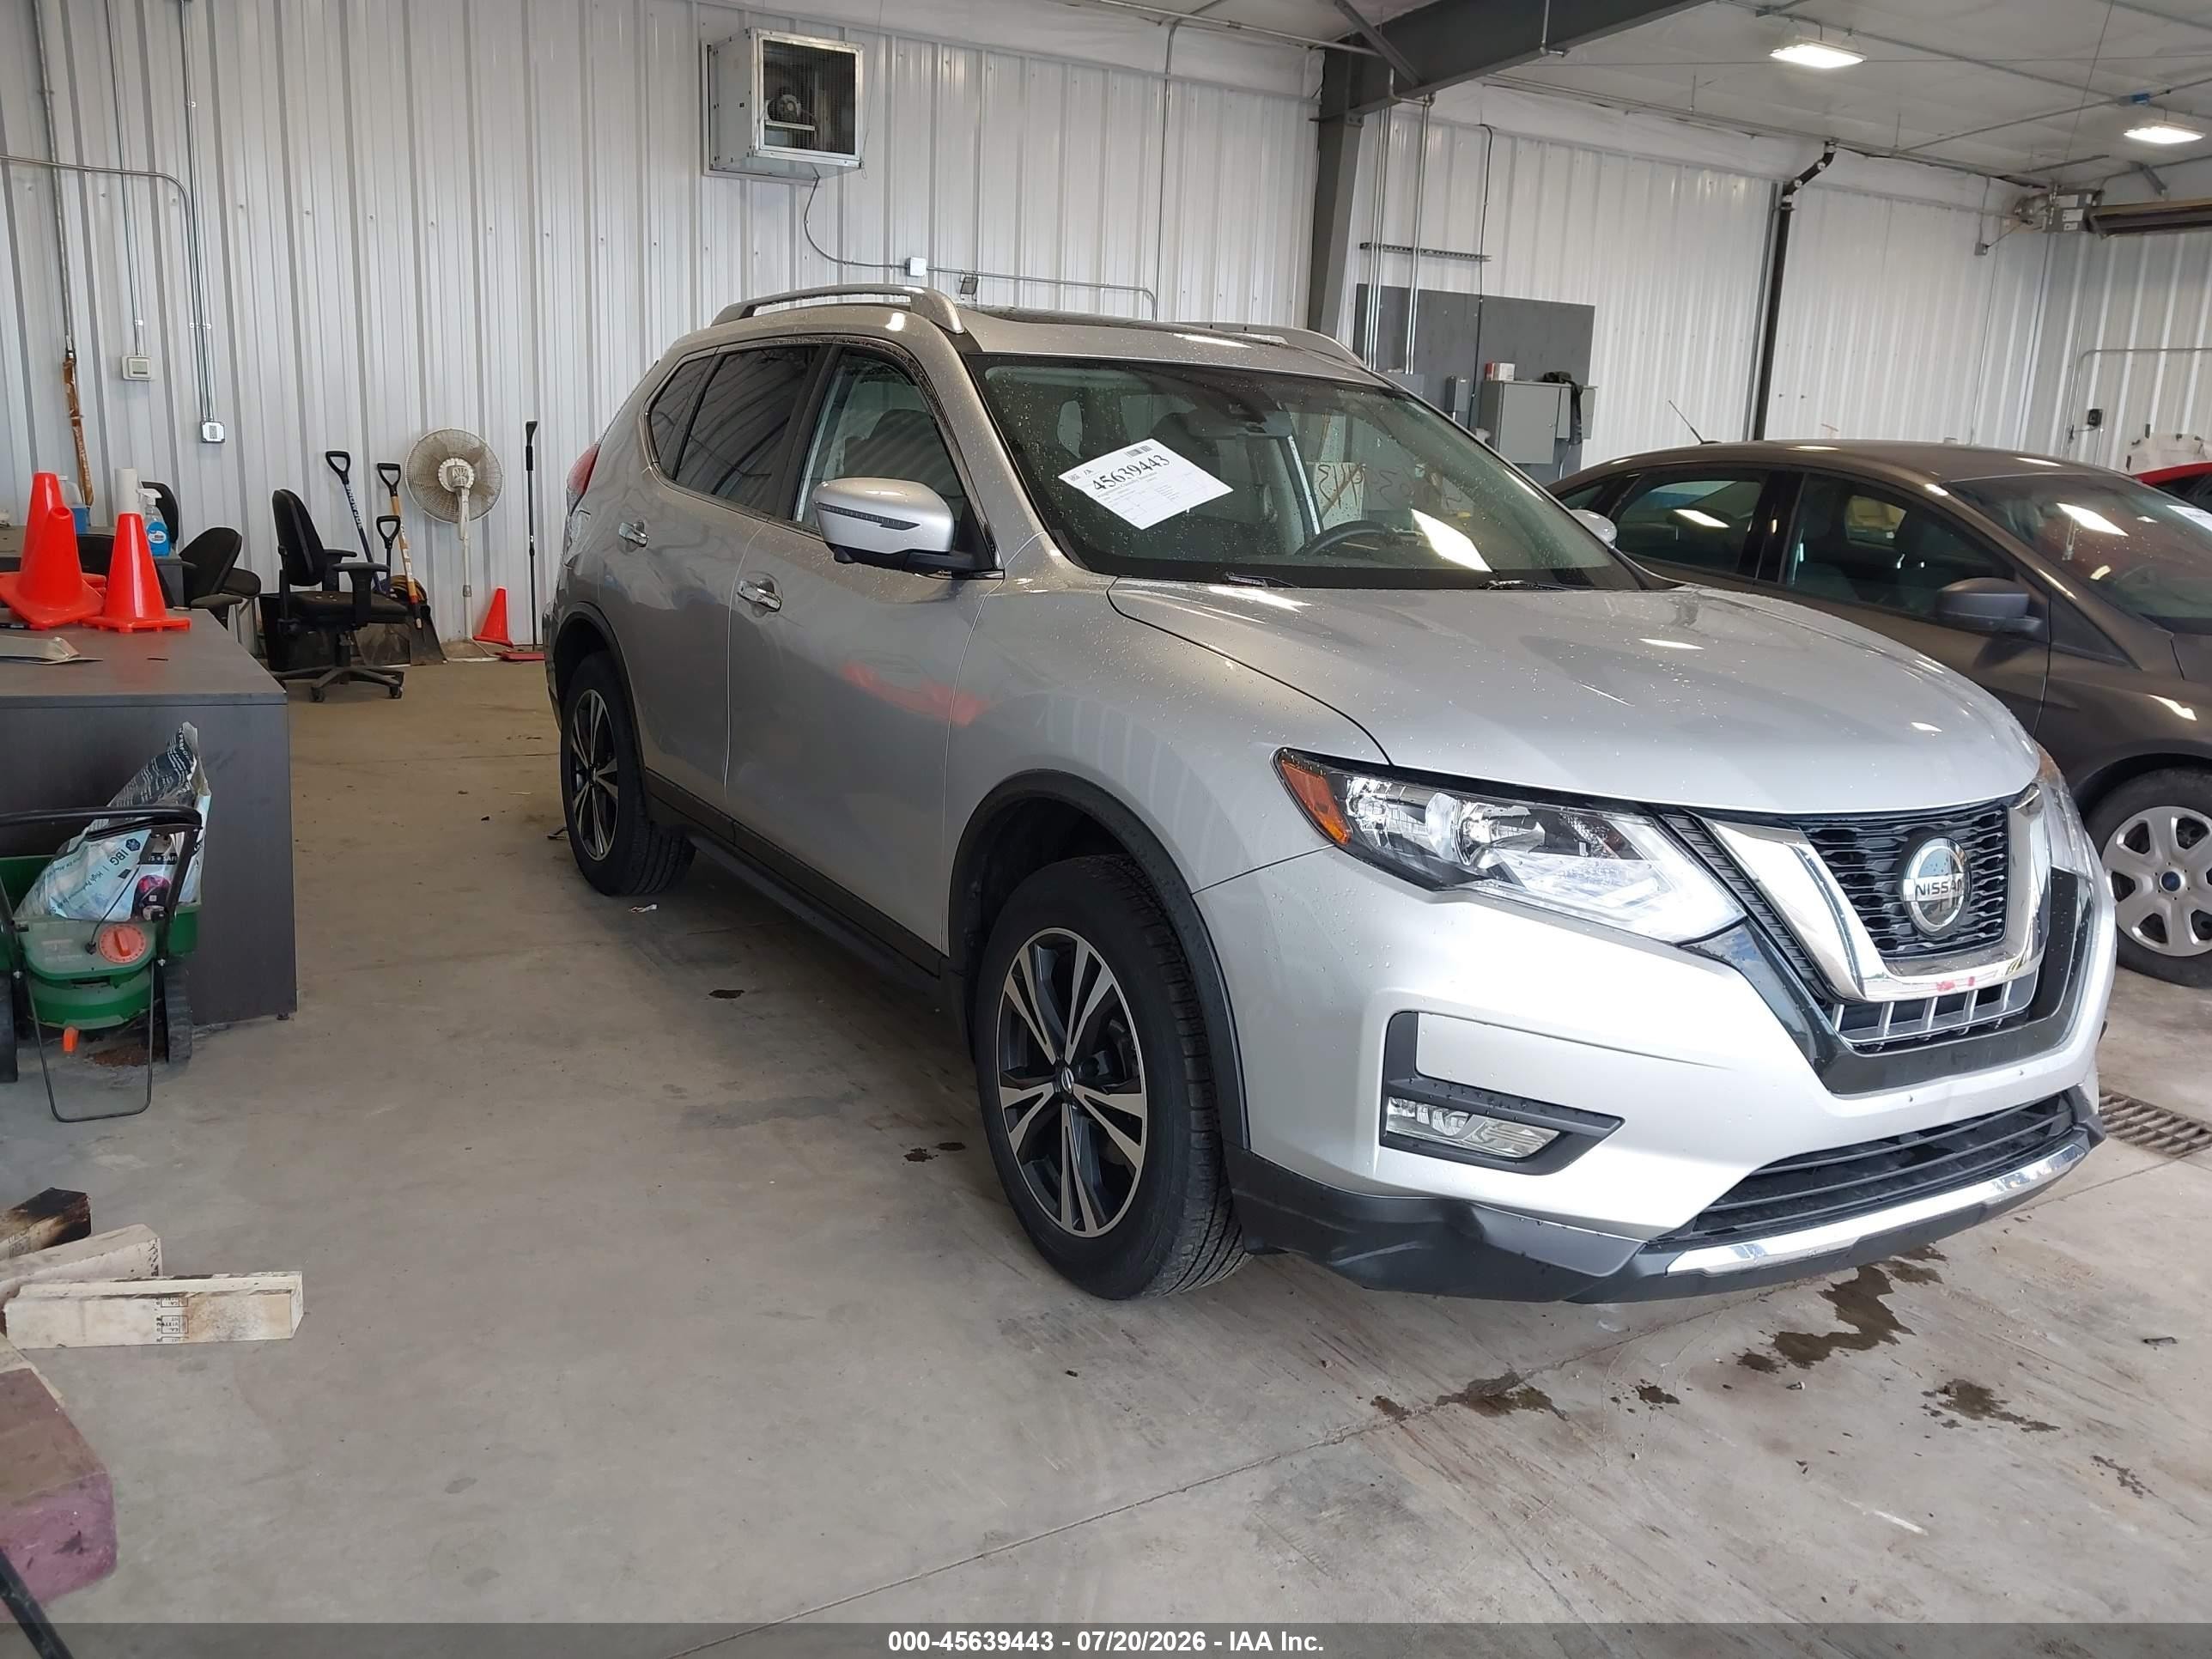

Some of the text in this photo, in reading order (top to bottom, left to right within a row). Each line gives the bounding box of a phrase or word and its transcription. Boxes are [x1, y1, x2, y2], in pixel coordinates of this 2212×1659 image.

[1093, 454, 1170, 491] 45639443
[109, 848, 129, 866] IBG
[1914, 879, 1963, 896] NISSAN
